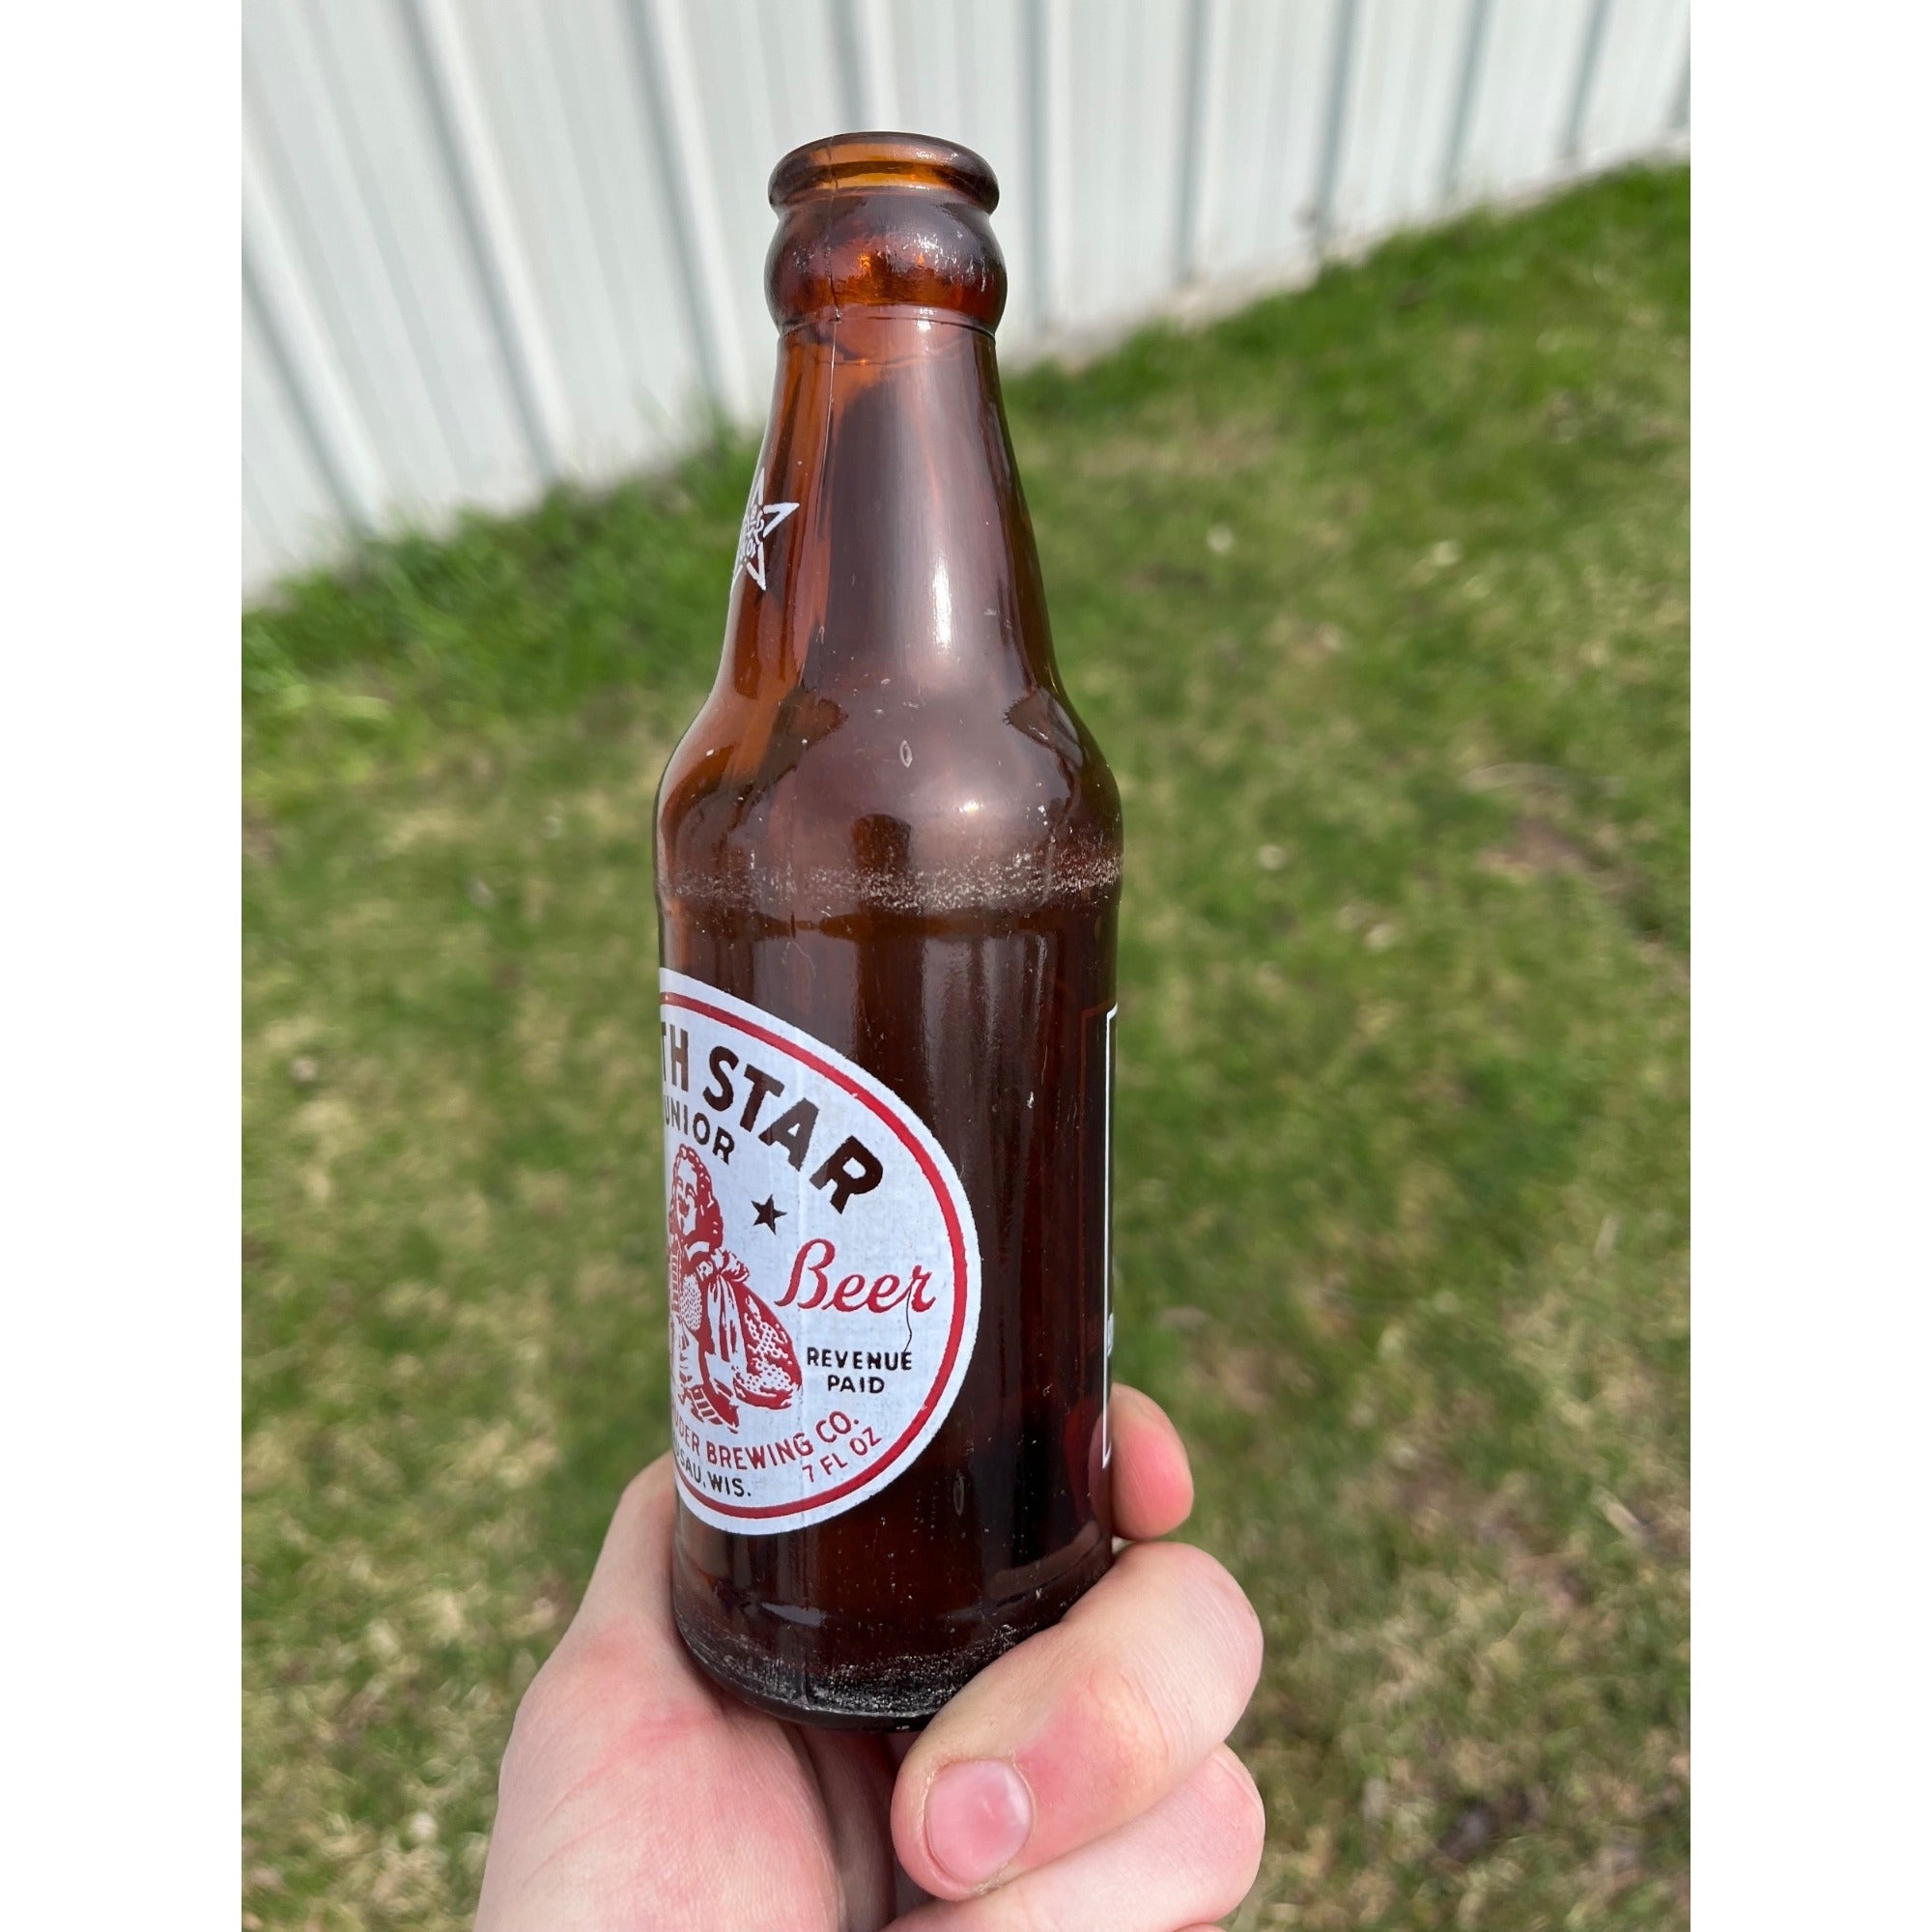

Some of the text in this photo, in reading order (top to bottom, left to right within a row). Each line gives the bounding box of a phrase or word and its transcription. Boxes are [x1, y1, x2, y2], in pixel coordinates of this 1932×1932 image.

[702, 1045, 884, 1215] STAR
[774, 1237, 936, 1314] Beer
[807, 1347, 913, 1371] REVENUE
[827, 1375, 886, 1395] PAID
[706, 1432, 814, 1471] BREWING
[815, 1410, 860, 1443] CO.
[802, 1426, 882, 1483] 7 FL OZ
[706, 1470, 752, 1497] WIS.
